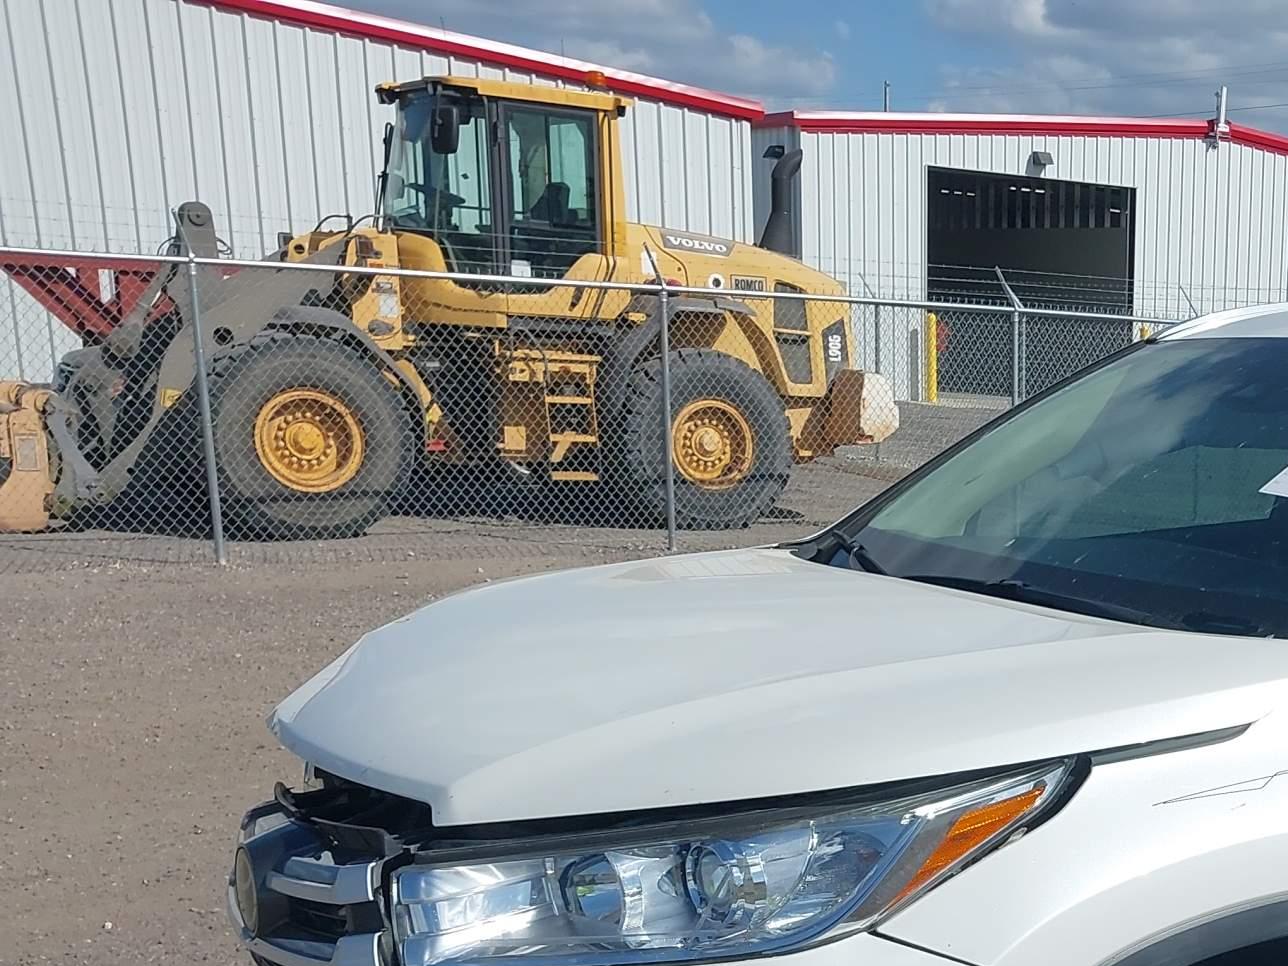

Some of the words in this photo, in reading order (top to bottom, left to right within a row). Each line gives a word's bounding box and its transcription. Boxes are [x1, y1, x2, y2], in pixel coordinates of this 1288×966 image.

[666, 235, 727, 253] VOLVO
[734, 278, 764, 291] ROMCO
[828, 333, 842, 363] L90G
